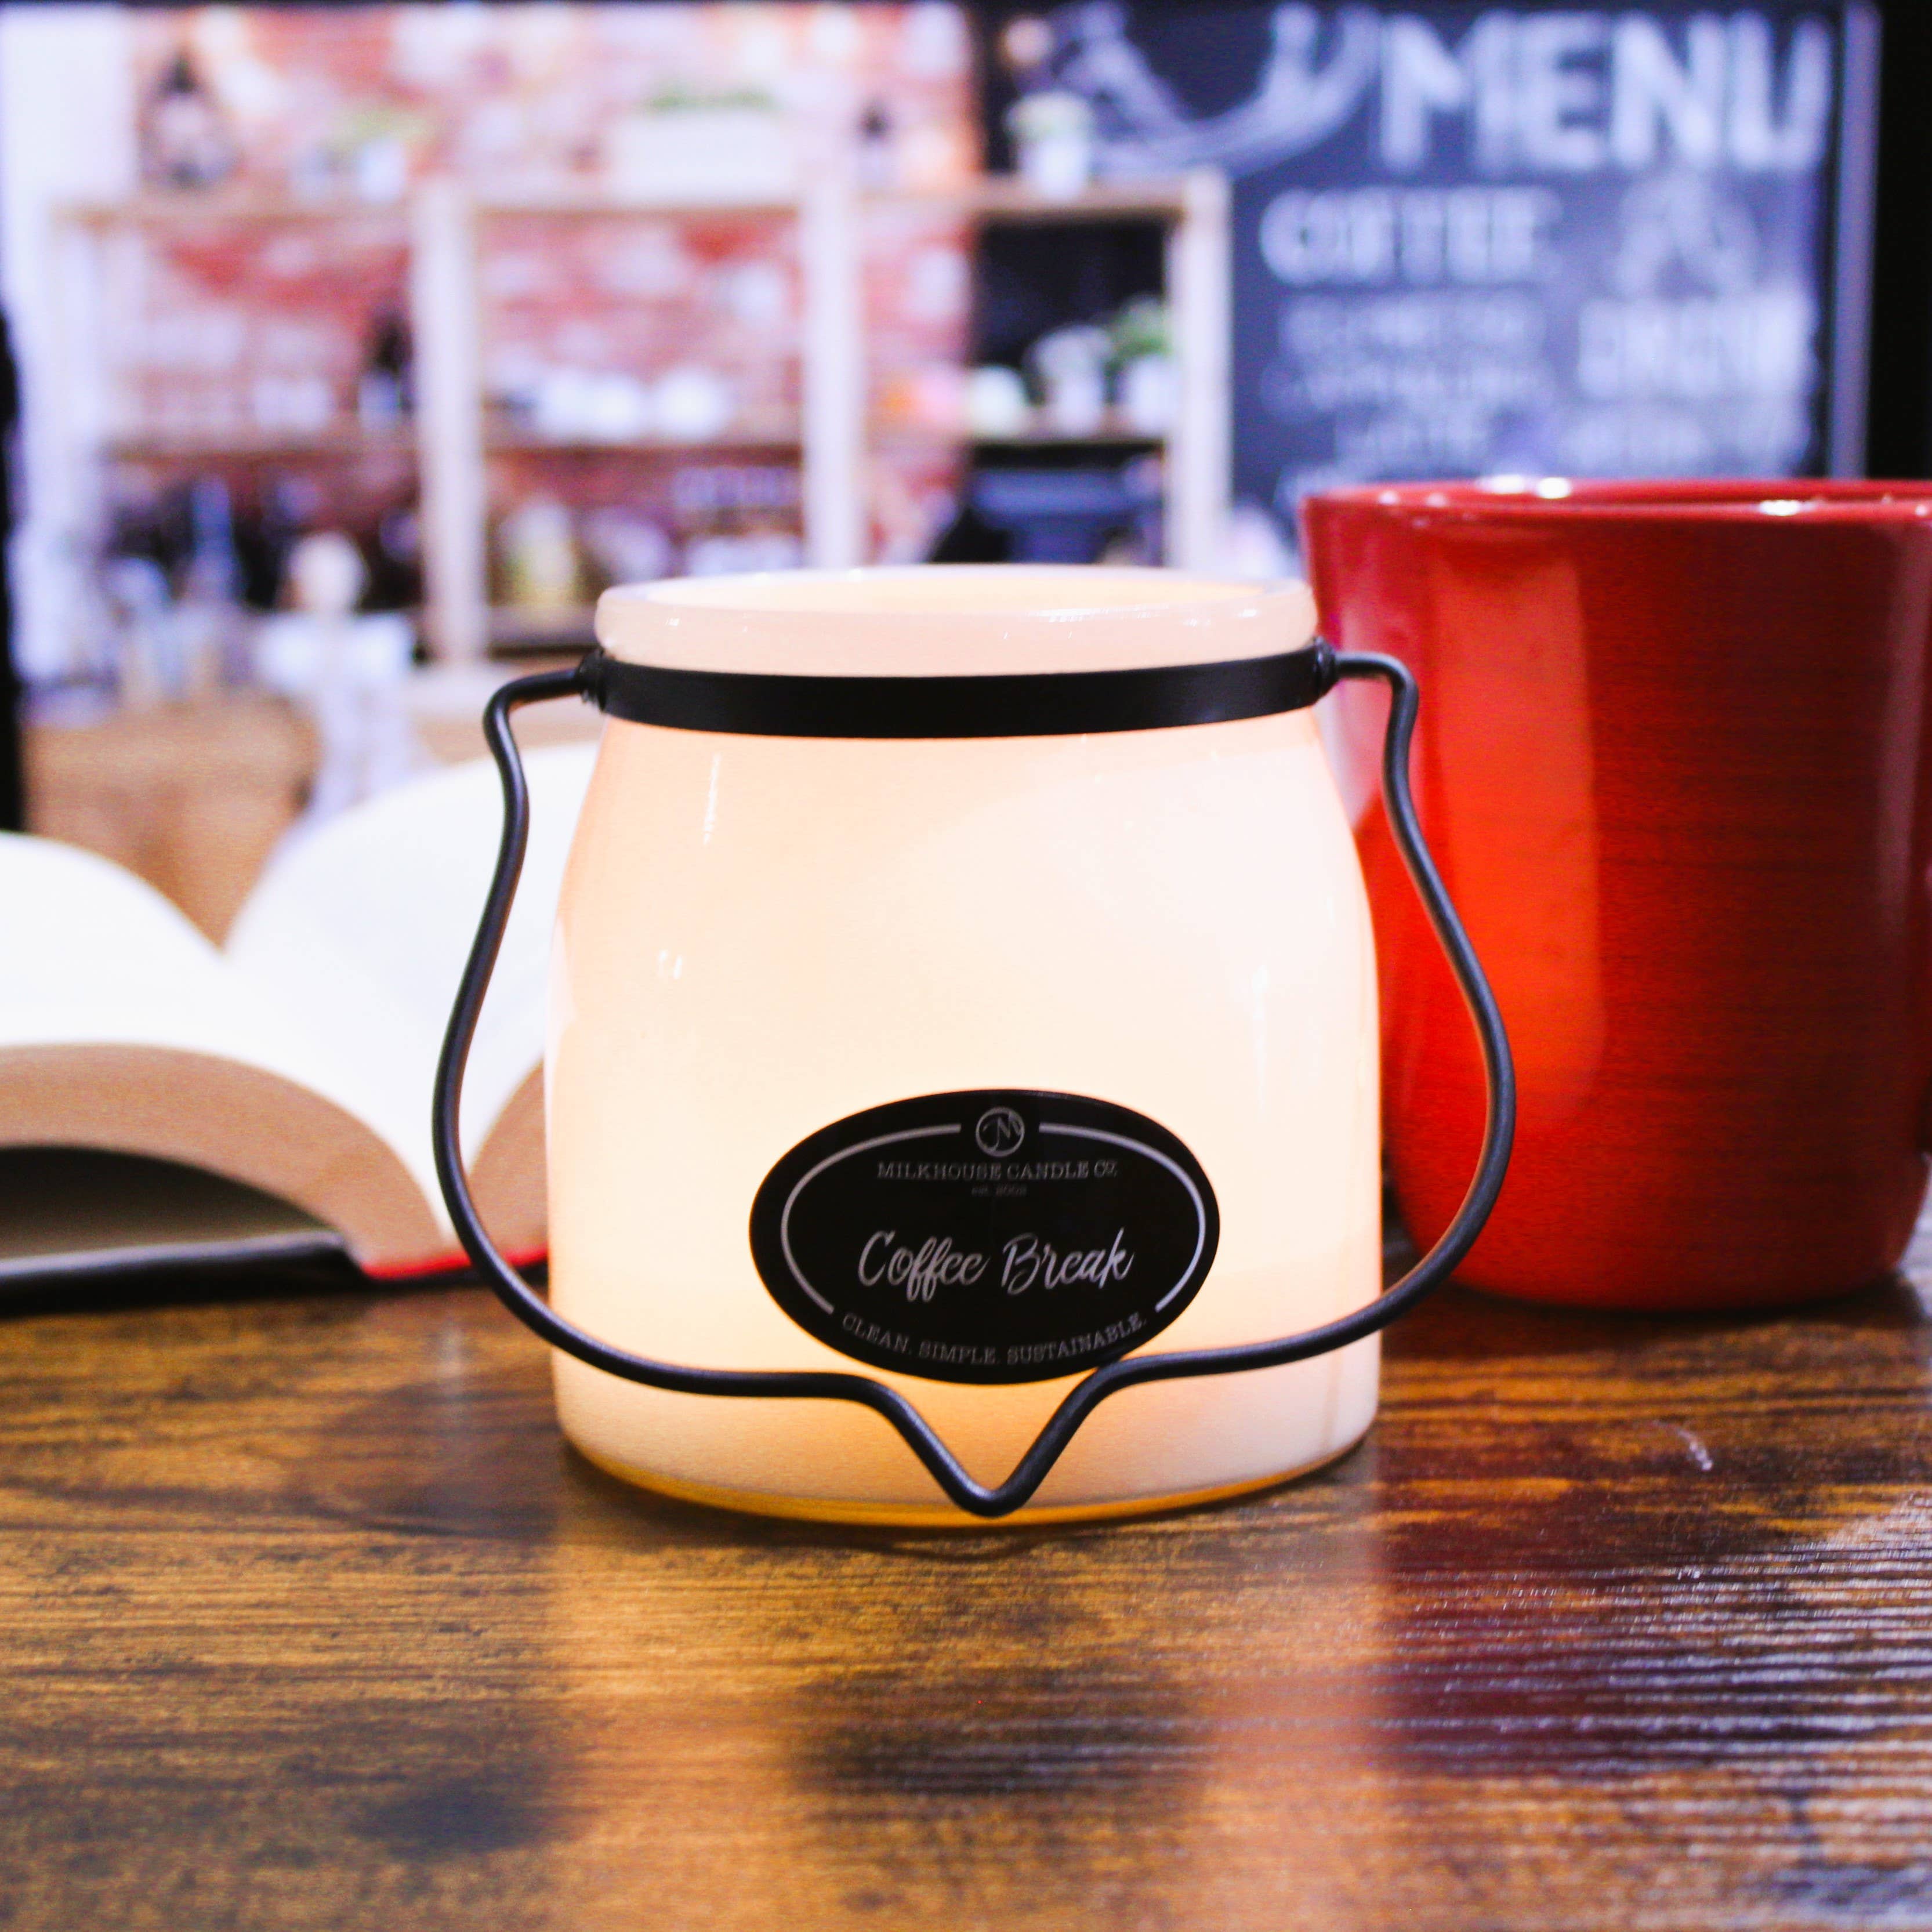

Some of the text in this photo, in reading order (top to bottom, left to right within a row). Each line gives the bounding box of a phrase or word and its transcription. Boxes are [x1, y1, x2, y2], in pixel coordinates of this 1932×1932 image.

[1377, 9, 1833, 174] MENU
[877, 1161, 1002, 1180] MILKHOUSE
[1007, 1161, 1089, 1180] CANDLE
[858, 1227, 1134, 1302] Coffee Break
